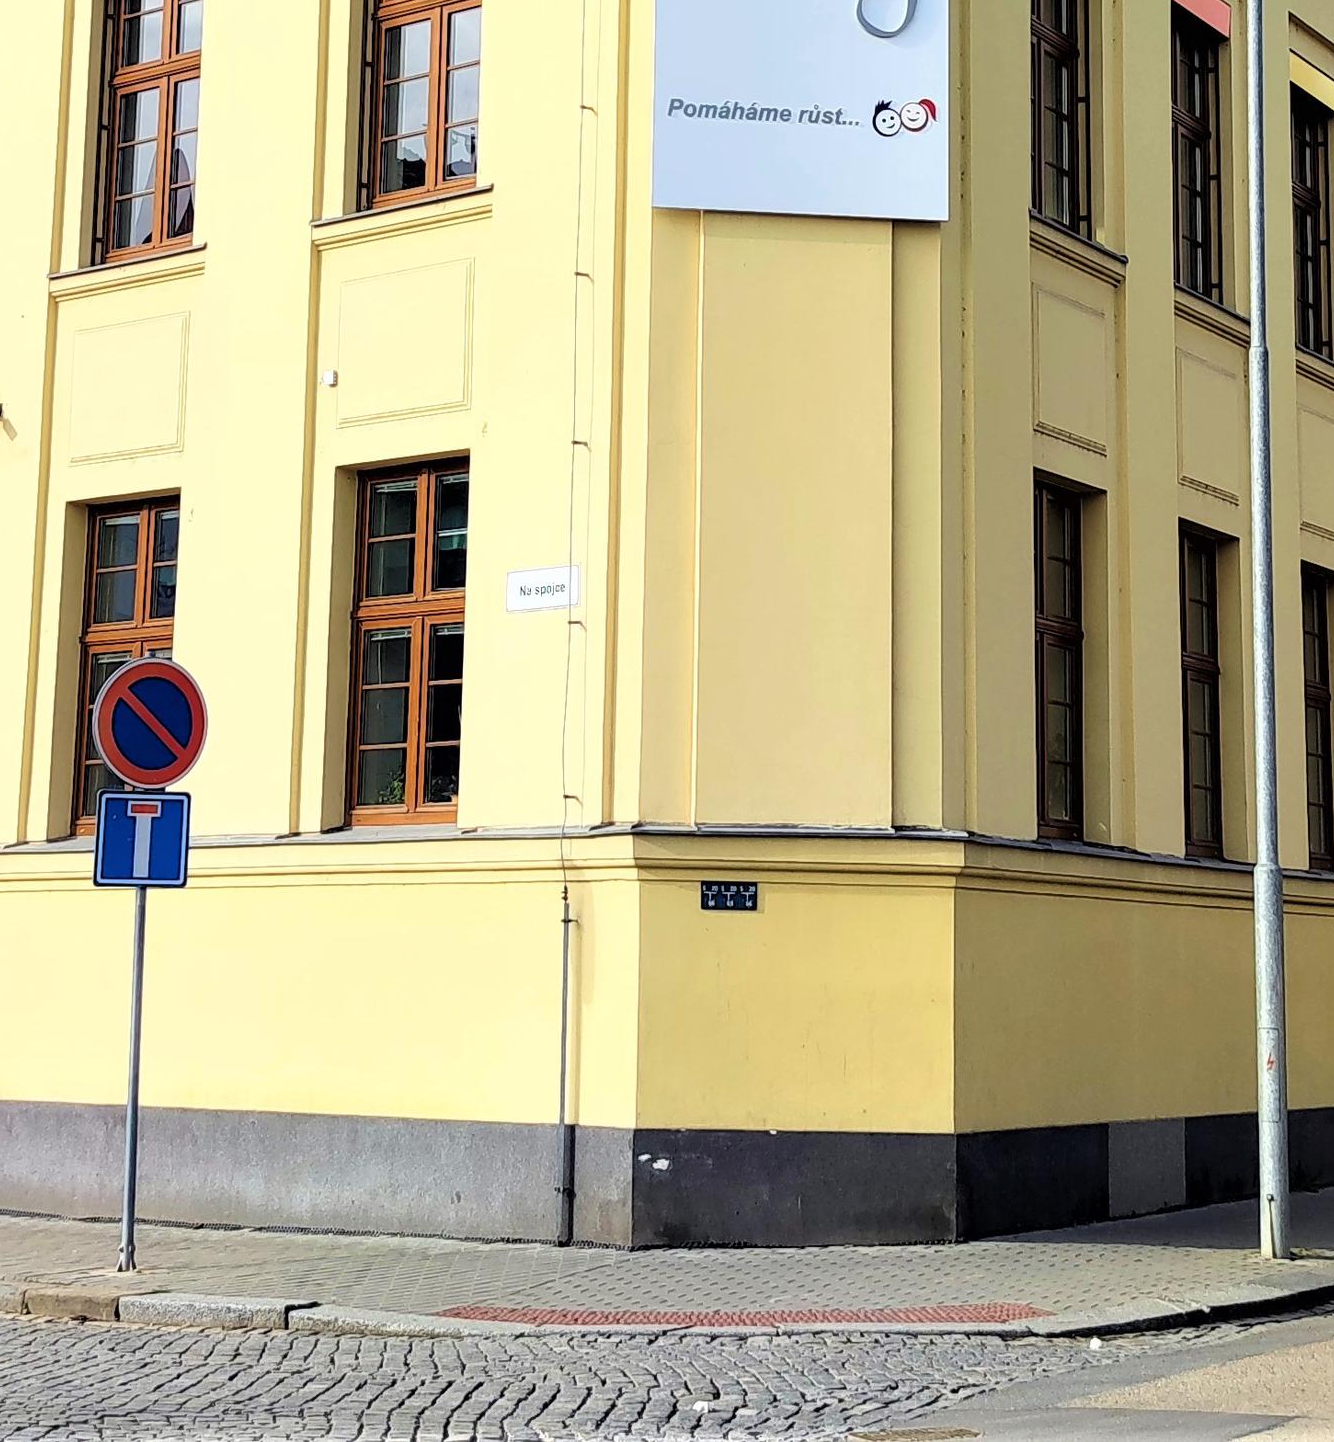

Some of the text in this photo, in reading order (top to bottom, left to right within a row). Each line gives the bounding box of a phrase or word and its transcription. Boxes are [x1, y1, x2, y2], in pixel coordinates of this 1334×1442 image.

[667, 98, 861, 126] Pomáháme růst...
[519, 582, 566, 597] Na spojce
